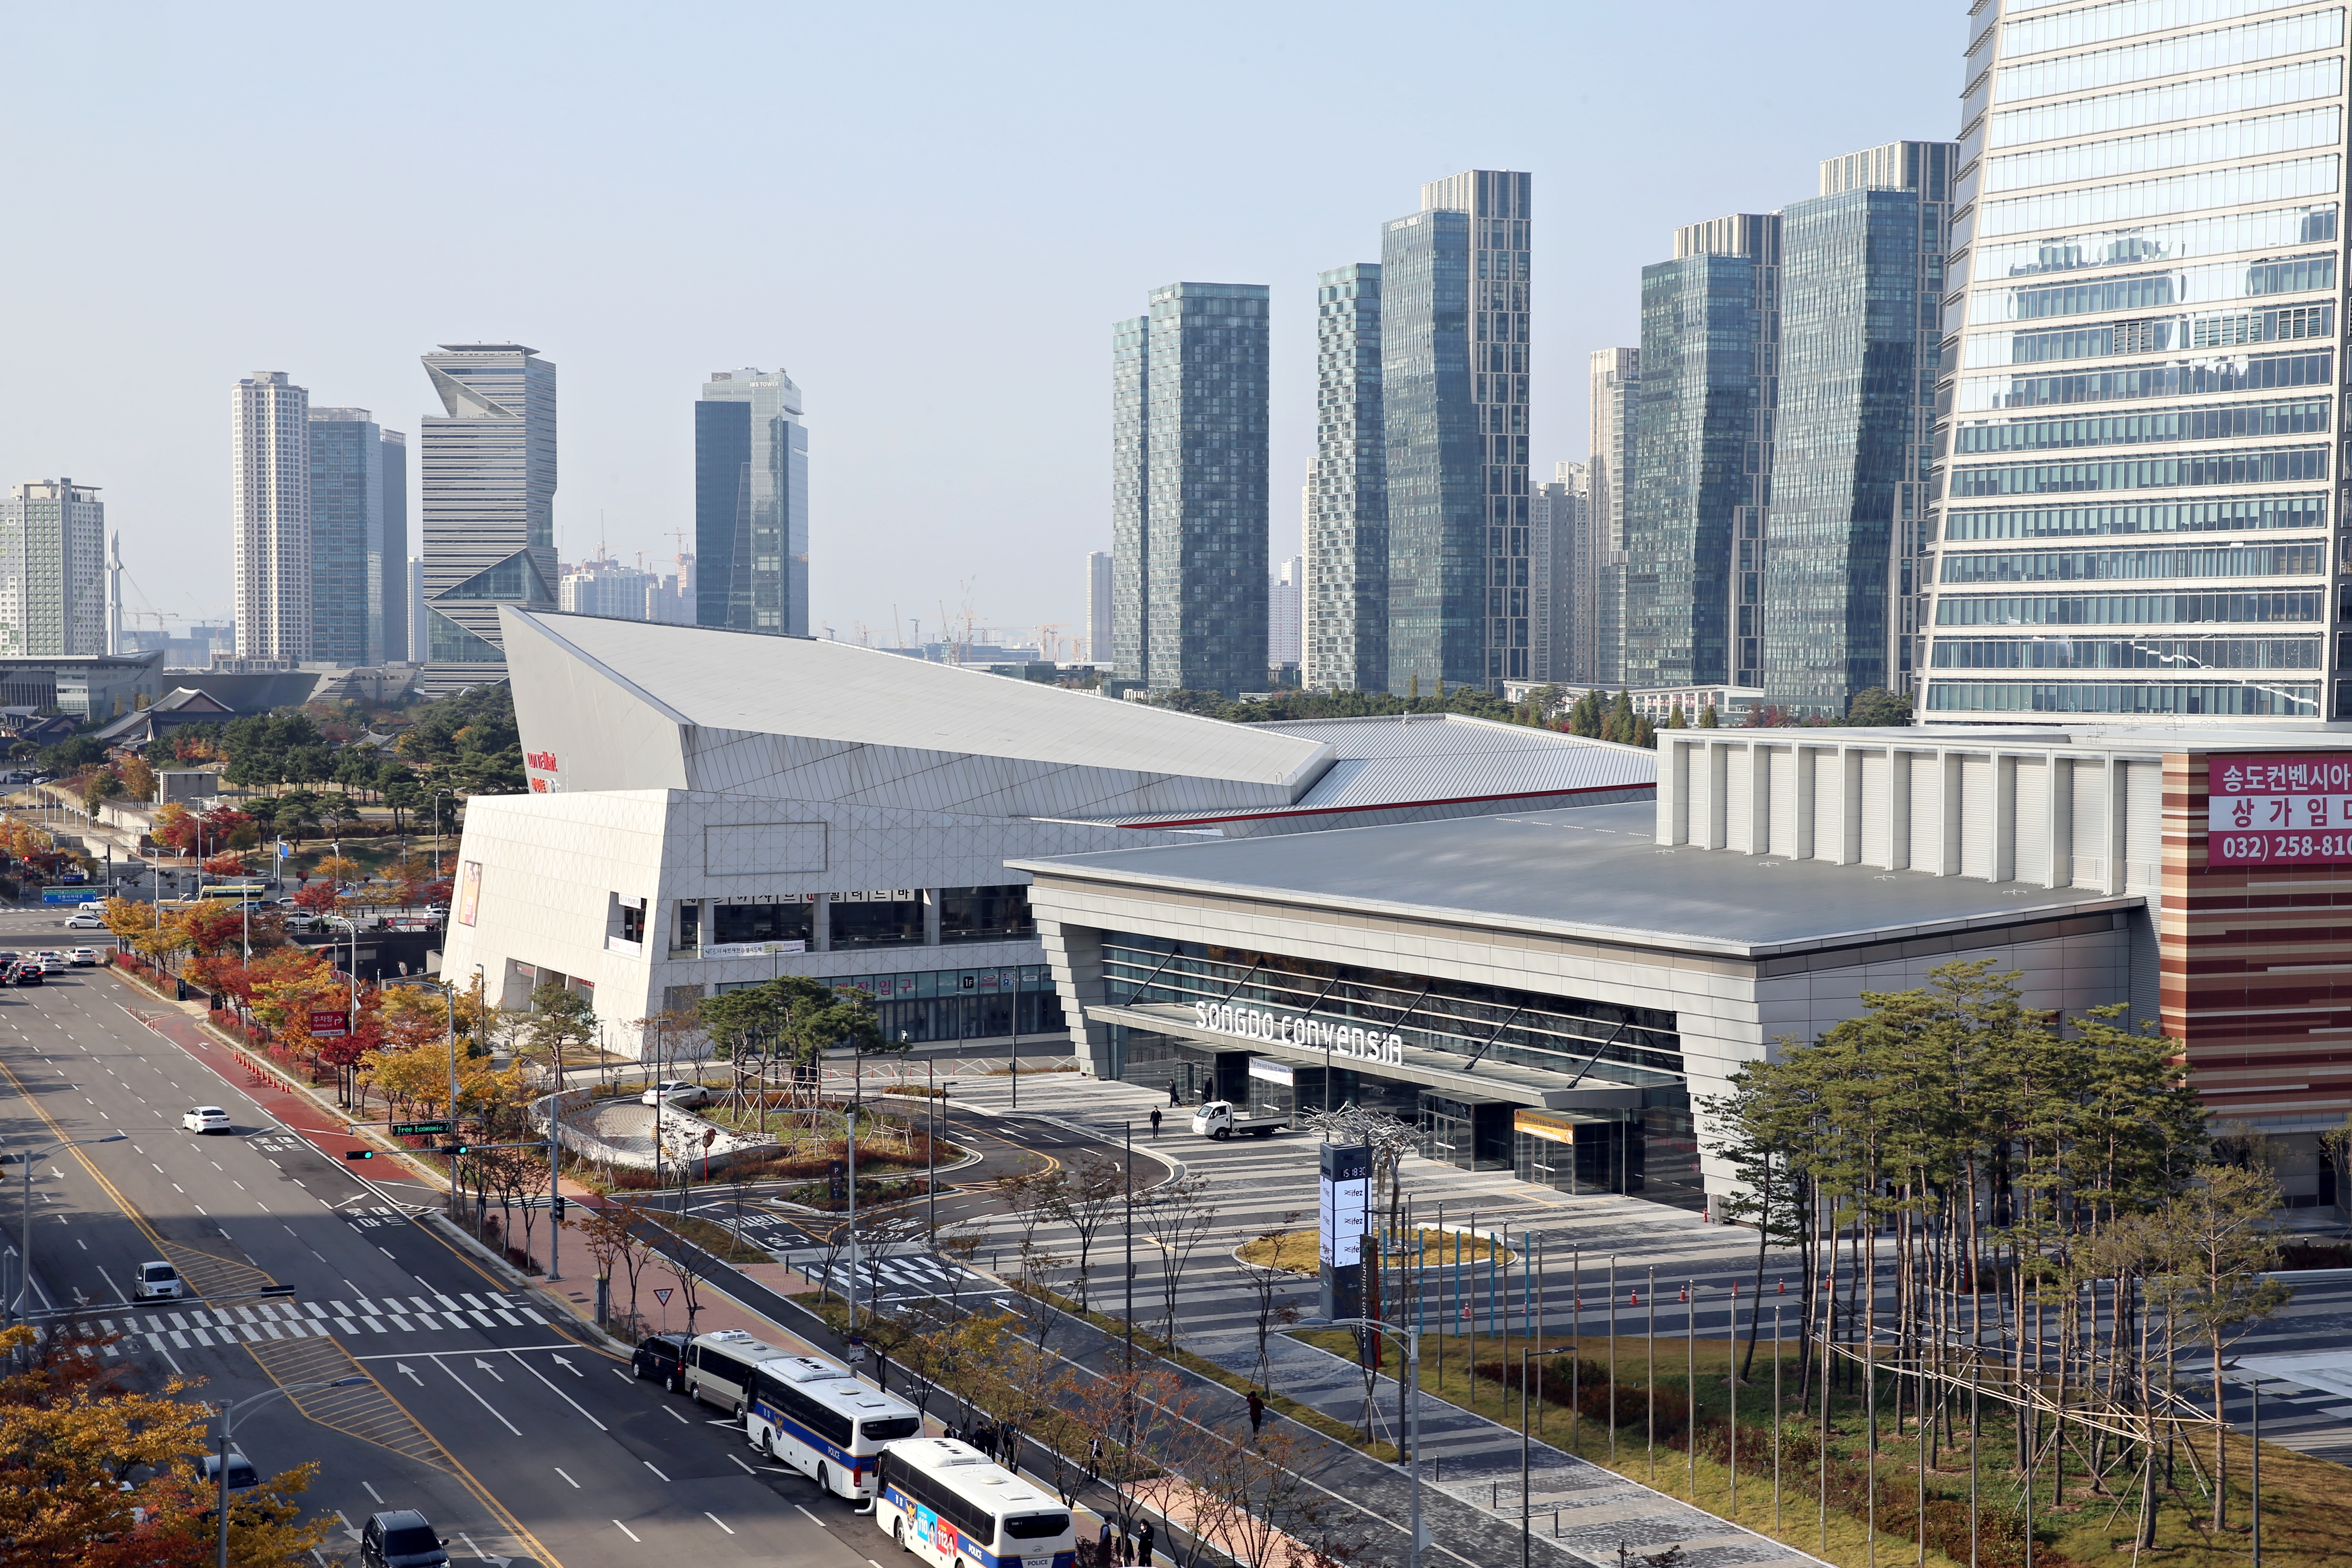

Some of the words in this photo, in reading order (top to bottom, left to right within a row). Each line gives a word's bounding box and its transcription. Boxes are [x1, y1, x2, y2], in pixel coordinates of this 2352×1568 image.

[2223, 835, 2269, 862] 032)
[764, 1235, 812, 1247] 출구
[763, 1408, 770, 1419] 경찰
[828, 1446, 840, 1460] POLICE
[895, 1494, 903, 1507] 경찰
[918, 1516, 928, 1535] 110
[938, 1529, 948, 1549] 112
[968, 1543, 982, 1560] POLICE
